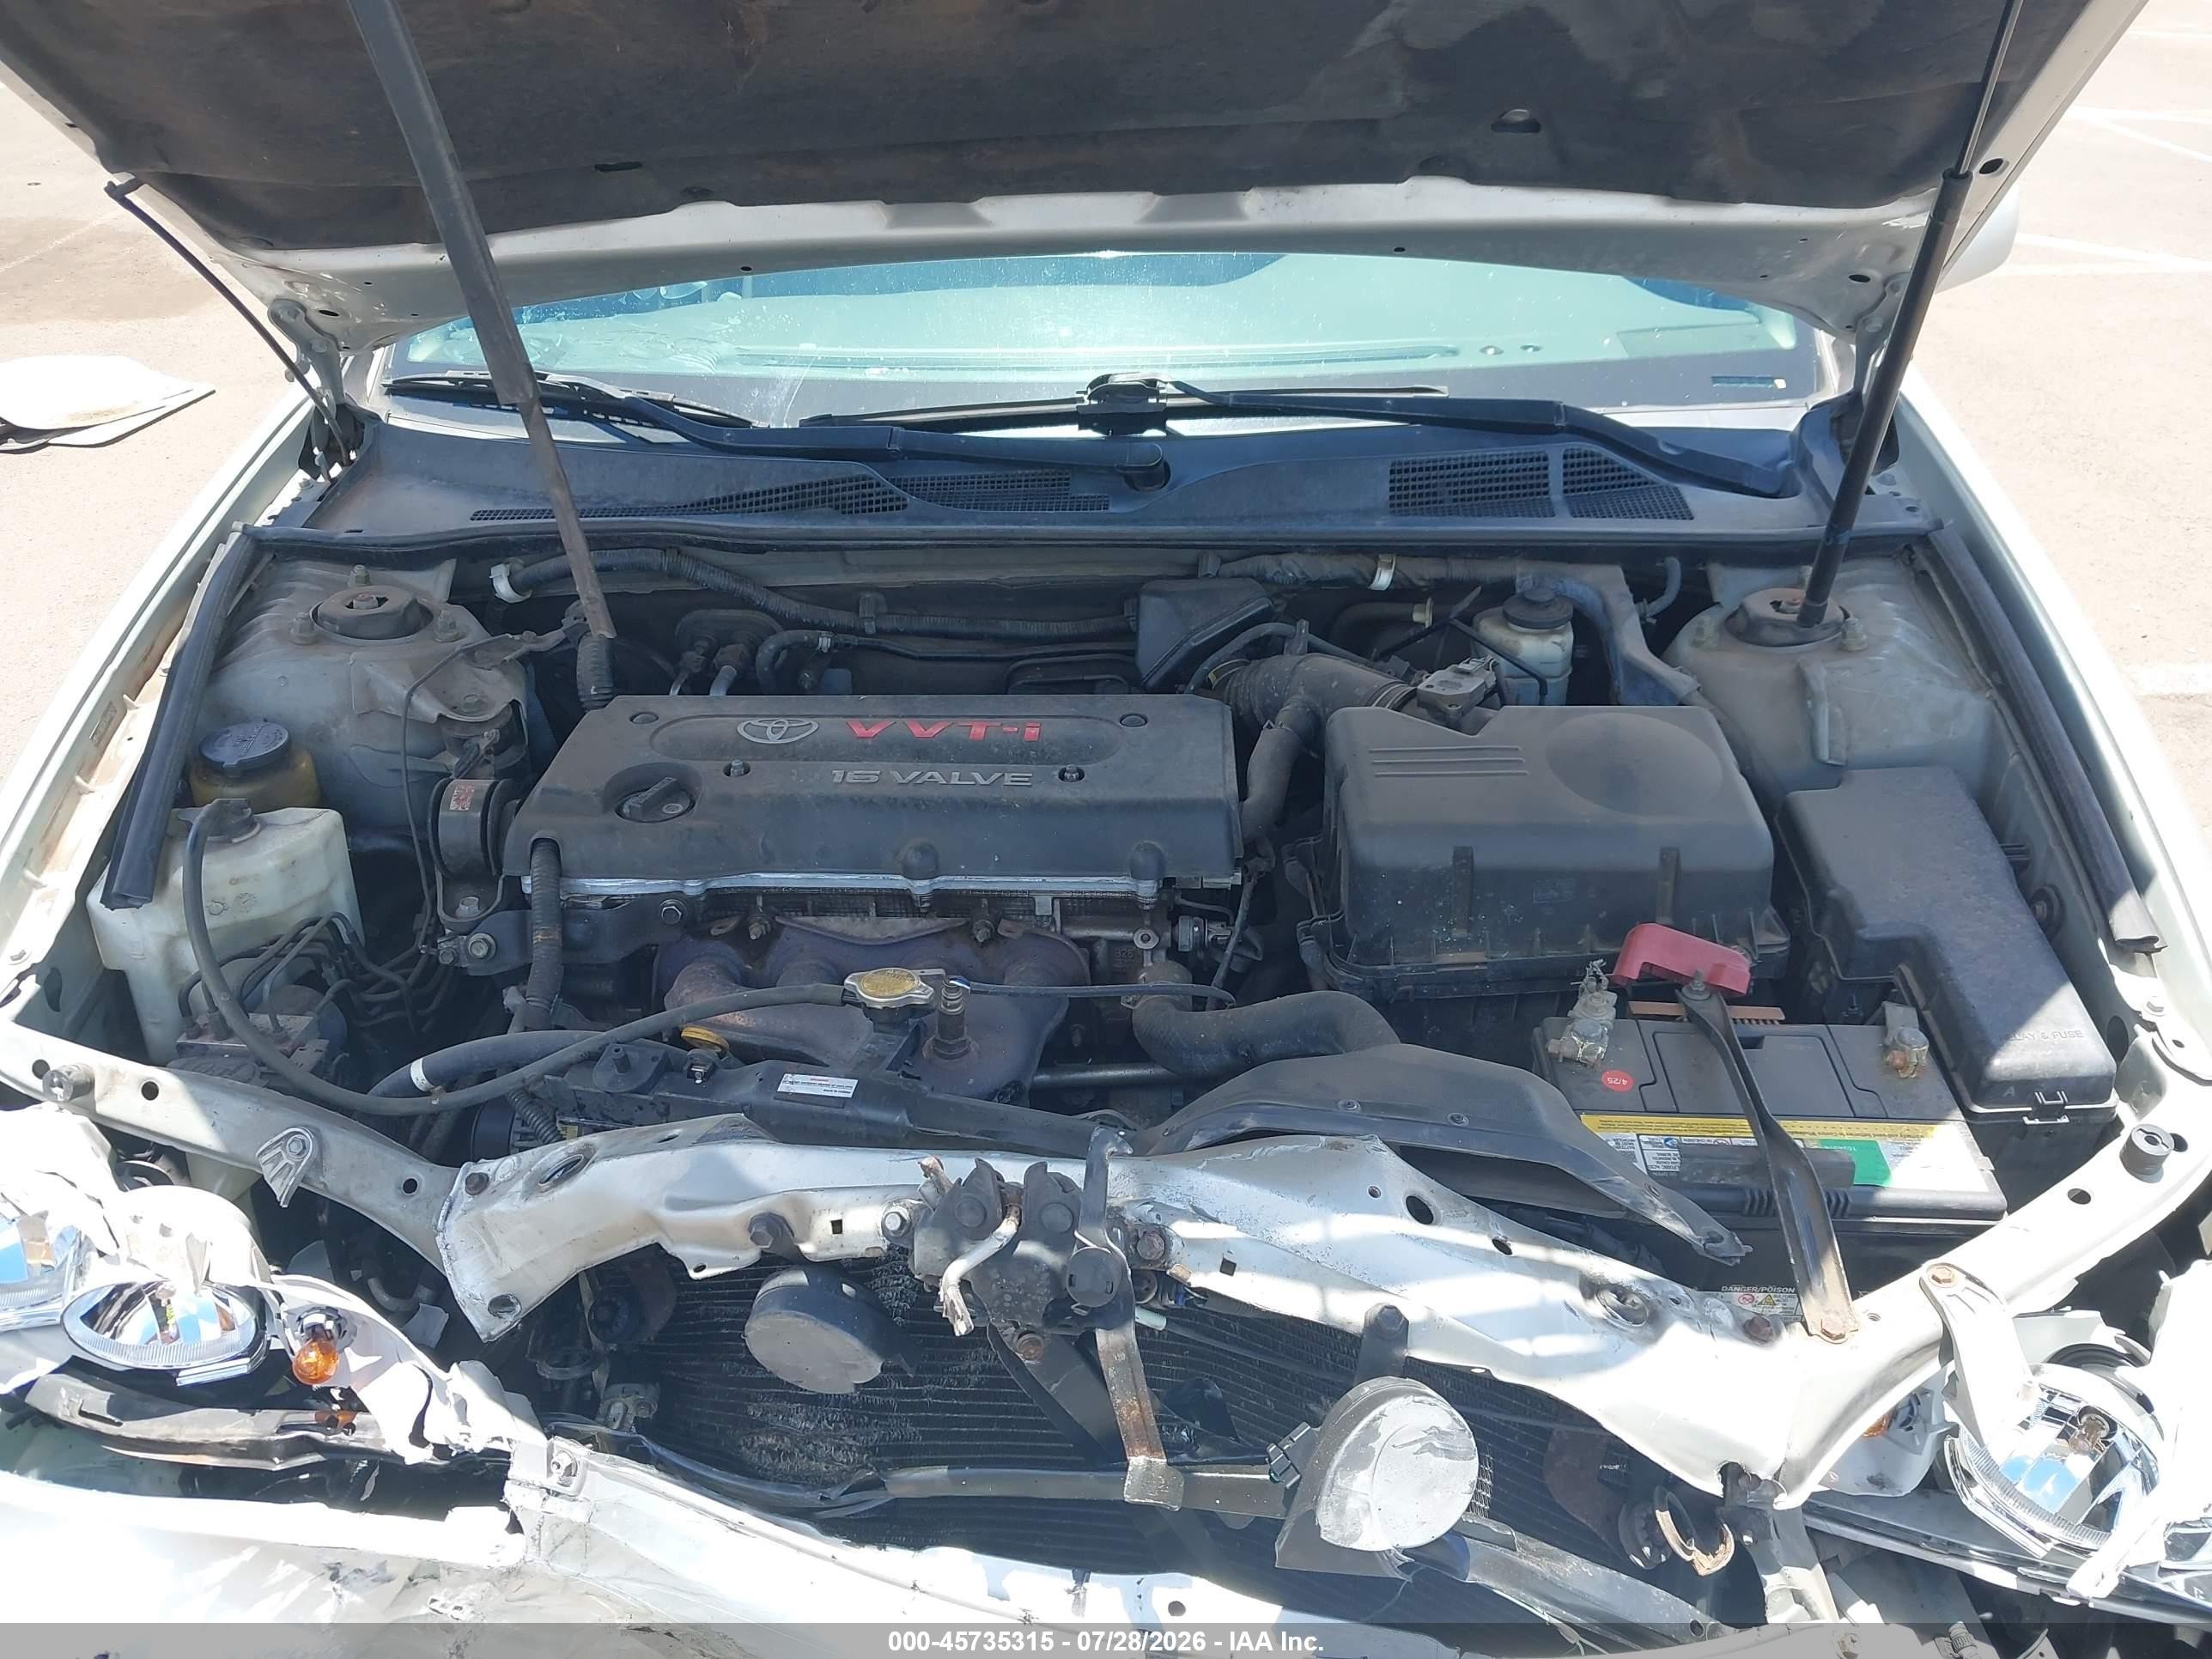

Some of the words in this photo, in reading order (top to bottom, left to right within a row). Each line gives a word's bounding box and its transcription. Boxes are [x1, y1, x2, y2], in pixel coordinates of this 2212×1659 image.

[846, 720, 1042, 742] VVT-i
[830, 769, 882, 785] 16
[890, 769, 1034, 787] VALVE
[2051, 1030, 2085, 1039] FUSE
[1607, 1077, 1628, 1085] 4/25
